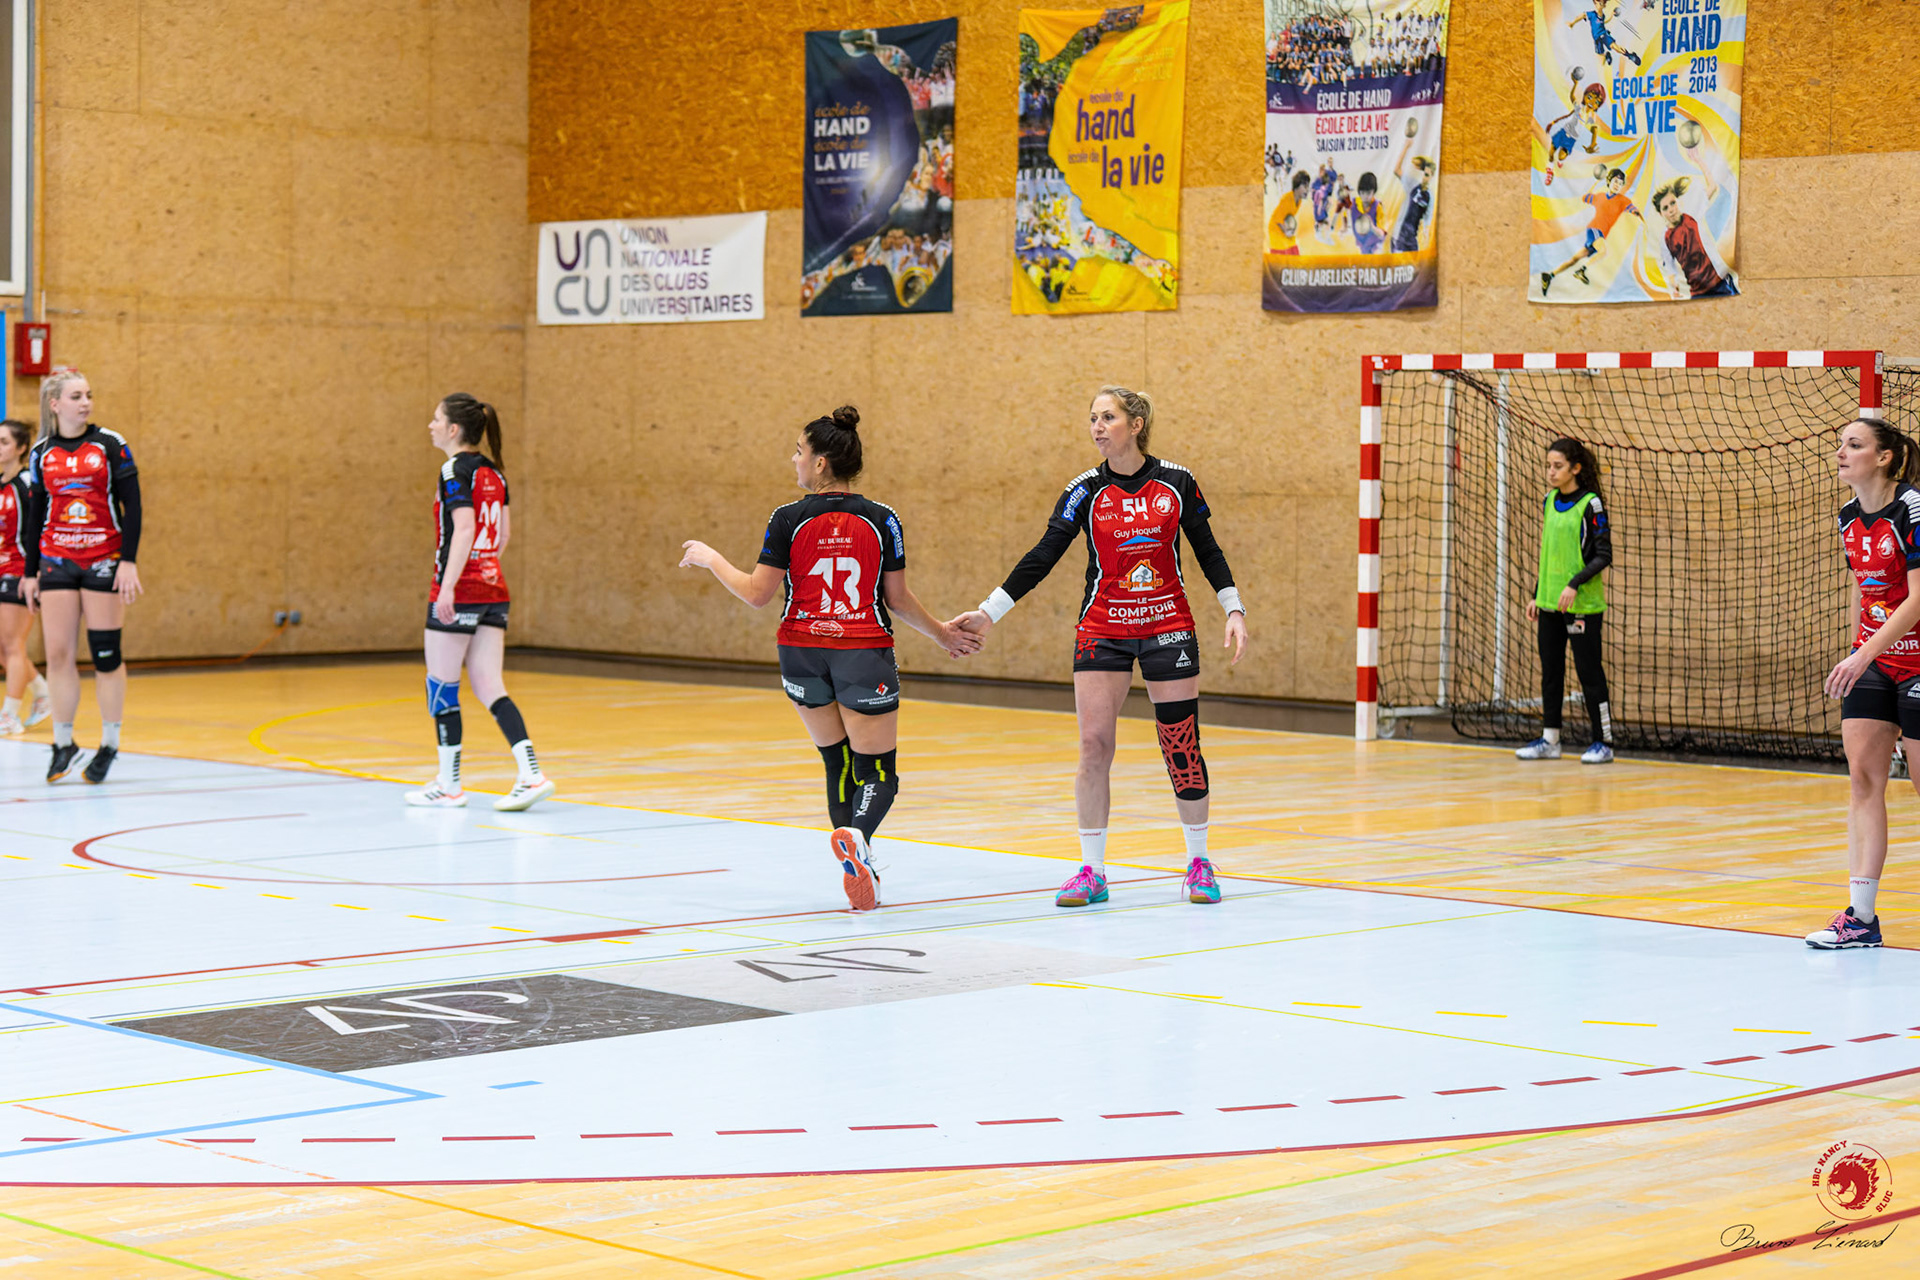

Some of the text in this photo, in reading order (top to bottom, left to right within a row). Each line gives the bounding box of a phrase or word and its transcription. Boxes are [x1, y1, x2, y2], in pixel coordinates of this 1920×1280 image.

[1704, 0, 1720, 12] DE
[1661, 14, 1721, 54] HAND
[1690, 56, 1717, 74] 2013
[1612, 71, 1678, 100] ÉCOLE DE
[1689, 75, 1717, 93] 2014
[1348, 91, 1362, 109] DE
[1363, 89, 1391, 108] HAND
[814, 116, 871, 137] HAND
[1076, 94, 1135, 142] hand
[1347, 115, 1359, 133] DE
[1361, 114, 1372, 132] LA
[1375, 113, 1389, 131] VIE
[1611, 100, 1677, 136] LA VIE
[1316, 135, 1389, 152] SAISON 2012-2013
[814, 152, 870, 171] LA VIE
[1102, 145, 1123, 188] la
[1130, 143, 1164, 186] vie
[620, 227, 669, 244] UNION
[620, 248, 711, 268] NATIONALE
[620, 272, 709, 292] DES CLUBS
[1281, 268, 1308, 286] CLUB
[1358, 267, 1378, 285] PAR
[1379, 267, 1393, 285] LA
[620, 294, 753, 316] UNIVERSITAIRES
[1122, 497, 1149, 523] 54
[828, 537, 854, 545] BUREAU
[1114, 525, 1162, 539] Guy Hoquet
[1862, 536, 1871, 562] 5
[808, 557, 861, 615] 13
[1108, 600, 1176, 618] COMPTOIR
[855, 783, 877, 817] Kempa
